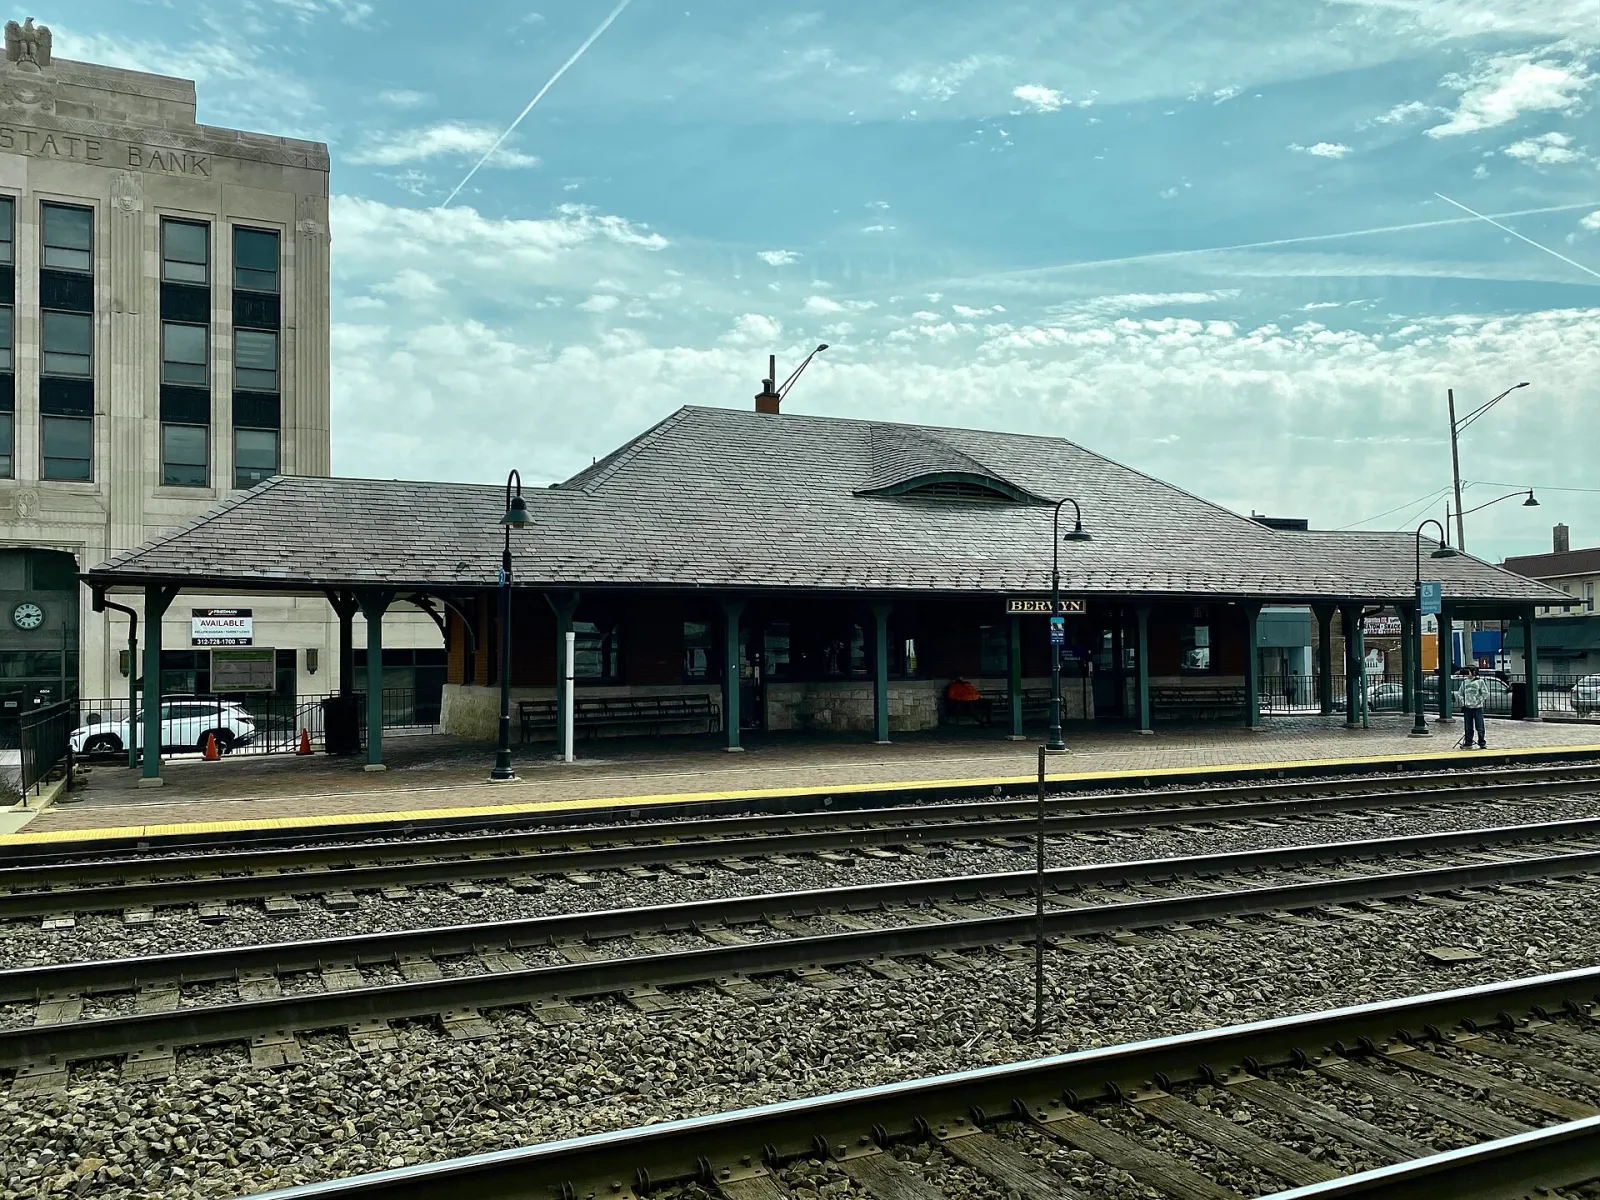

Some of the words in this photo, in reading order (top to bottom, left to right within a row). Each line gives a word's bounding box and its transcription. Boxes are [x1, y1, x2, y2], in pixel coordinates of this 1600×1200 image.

[0, 127, 103, 161] STATE
[126, 145, 210, 177] BANK
[200, 619, 245, 627] AVAILABLE
